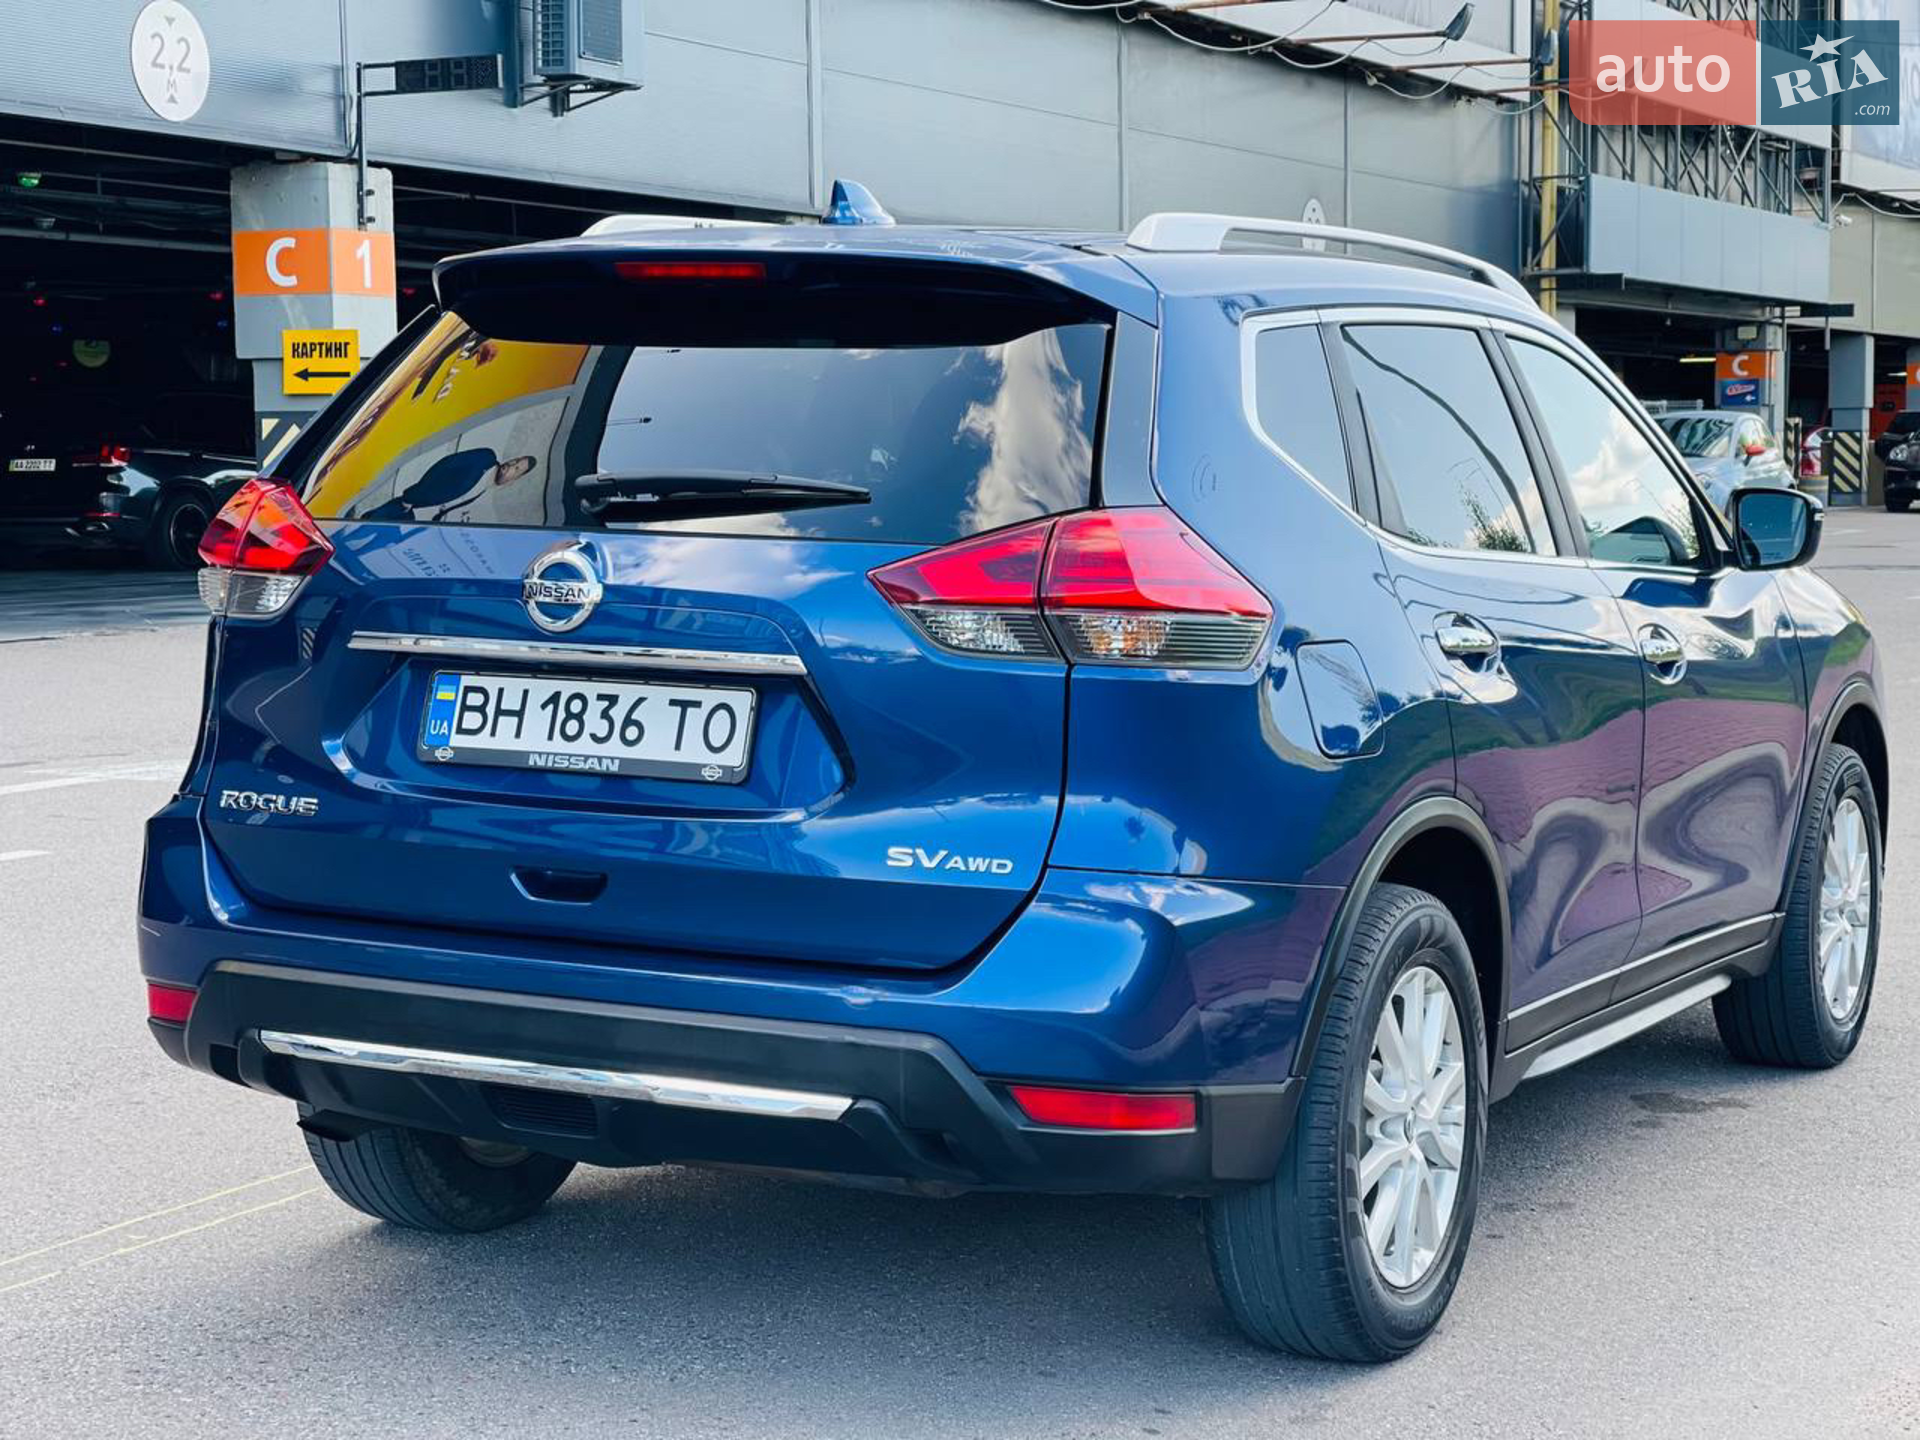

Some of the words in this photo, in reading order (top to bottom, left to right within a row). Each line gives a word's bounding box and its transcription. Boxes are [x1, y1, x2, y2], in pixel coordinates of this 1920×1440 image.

[150, 32, 192, 77] 2,2
[356, 239, 372, 289] 1
[291, 341, 351, 359] КАРТИНГ
[525, 584, 591, 599] NISSAN
[430, 719, 449, 736] UA
[455, 685, 530, 740] BH
[540, 690, 648, 747] 1836
[668, 699, 737, 754] TO
[528, 753, 620, 772] NISSAN
[220, 789, 319, 817] ROGUE
